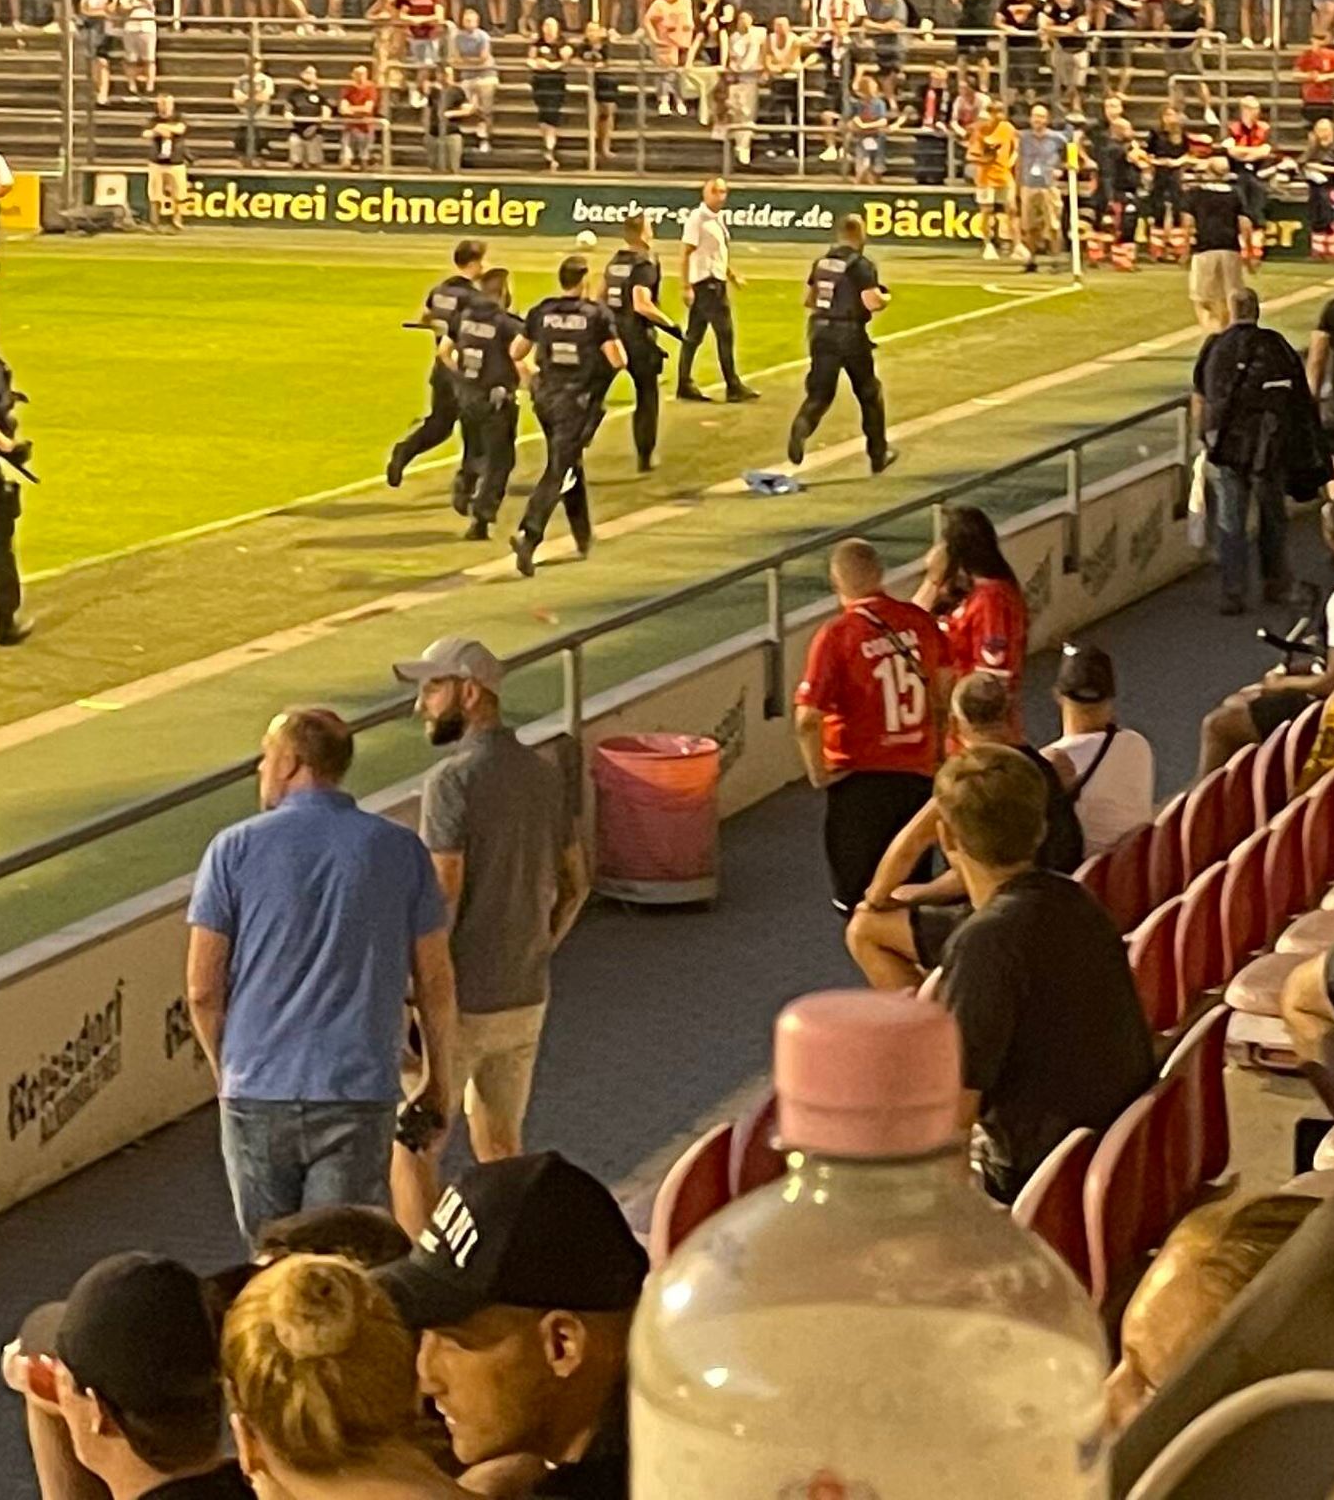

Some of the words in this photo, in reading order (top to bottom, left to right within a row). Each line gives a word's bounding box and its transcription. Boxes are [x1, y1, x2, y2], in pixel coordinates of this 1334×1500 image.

[335, 187, 545, 227] Schneider
[572, 198, 833, 229] baecker-sneider.de
[863, 199, 1012, 239] Bäcke
[872, 650, 927, 733] 15
[7, 978, 125, 1142] Reissdorf
